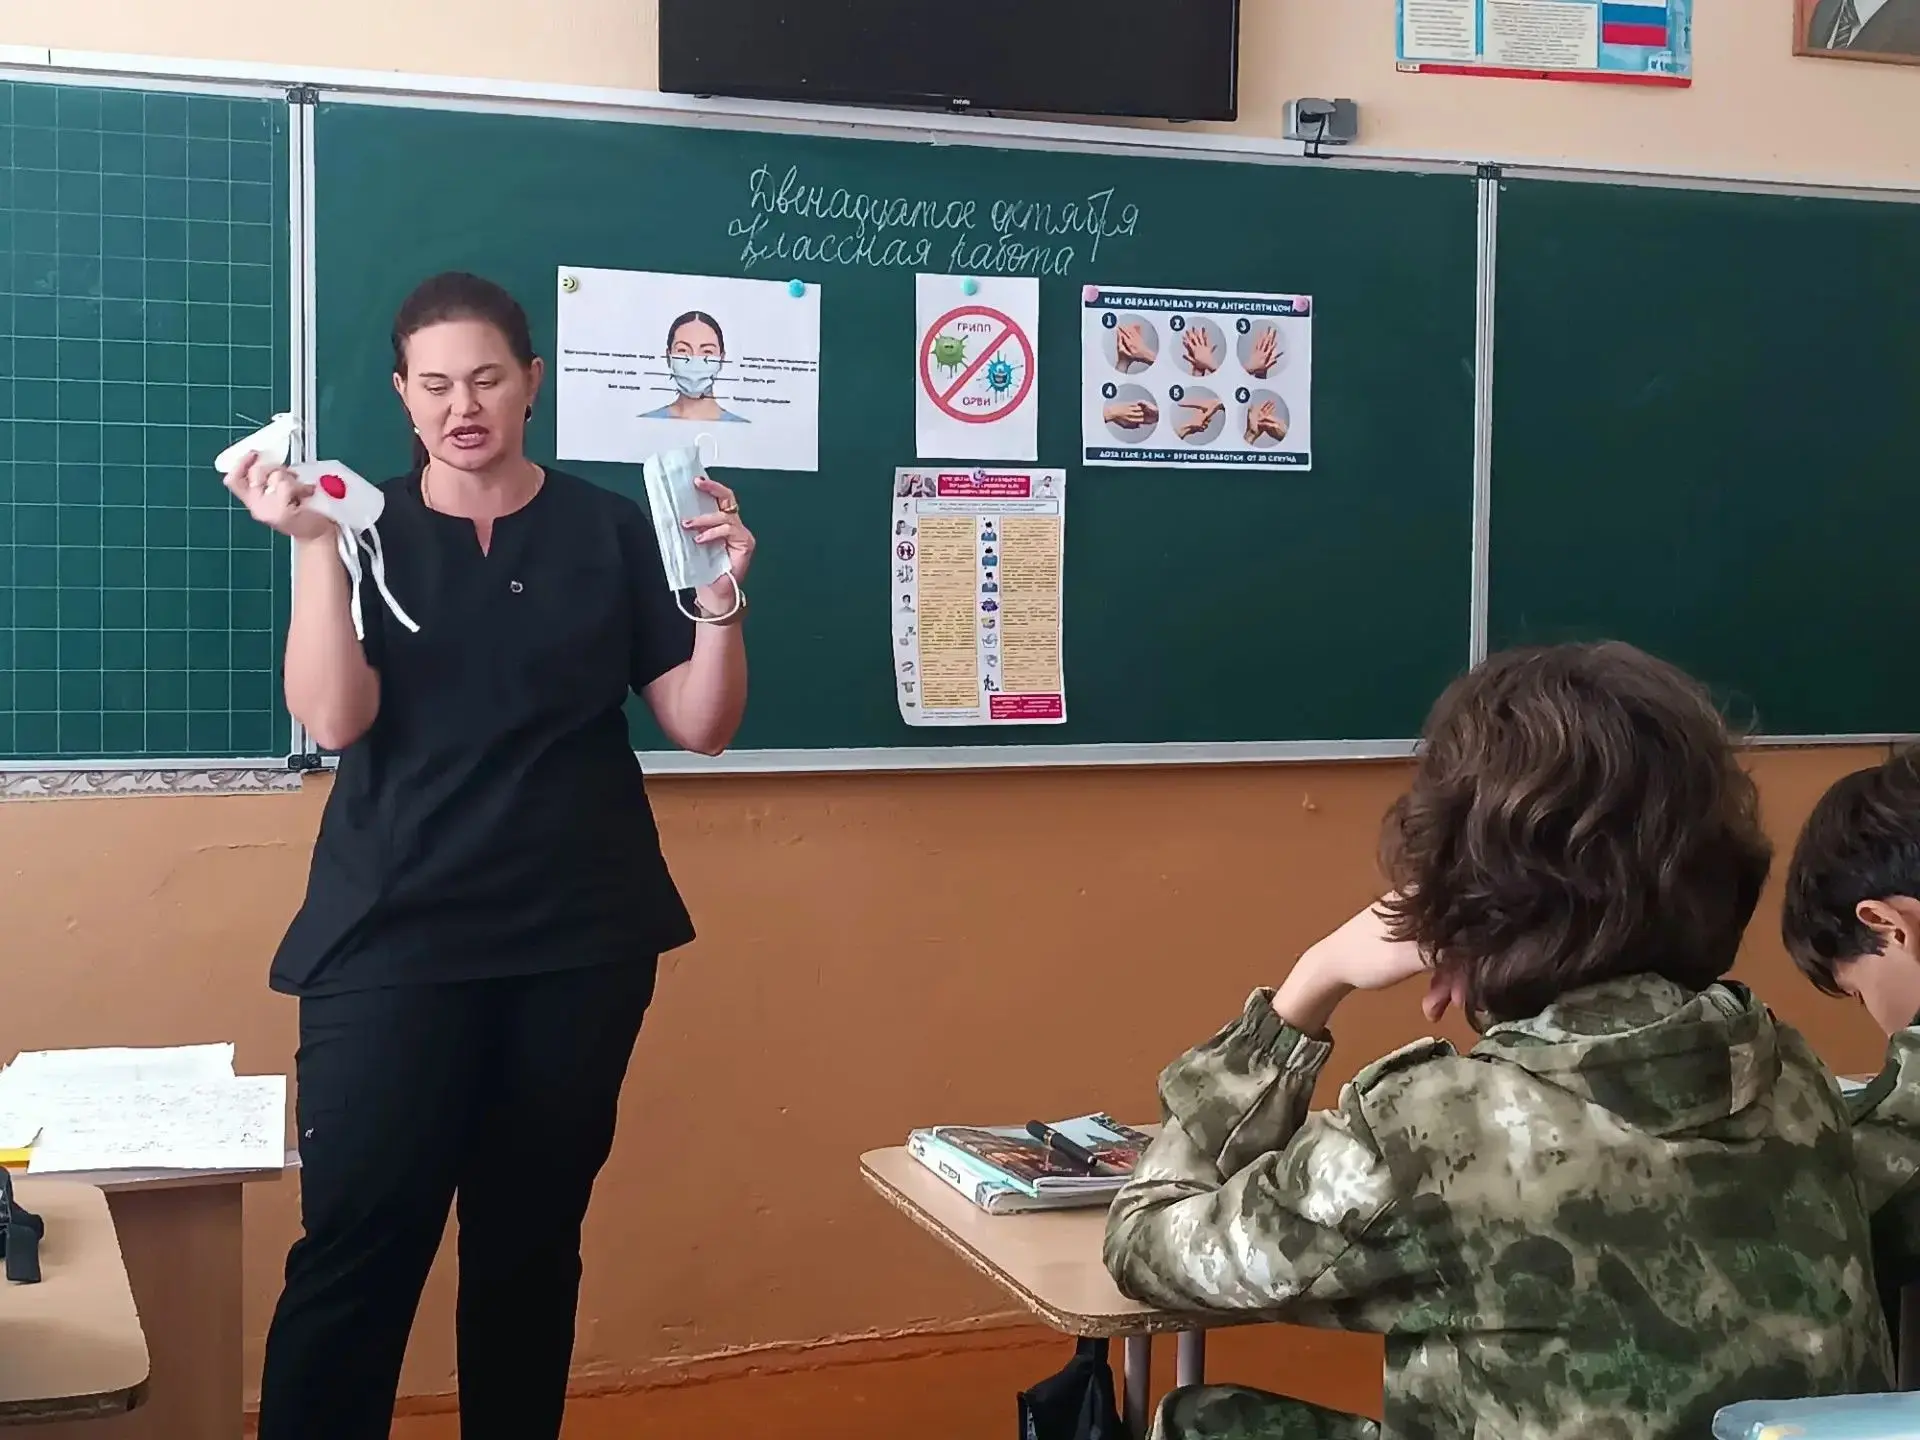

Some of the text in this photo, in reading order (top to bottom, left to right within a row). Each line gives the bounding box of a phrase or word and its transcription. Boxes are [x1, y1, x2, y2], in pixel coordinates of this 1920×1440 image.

[749, 163, 1140, 264] Двенадцатое октября
[727, 211, 1075, 277] Классная работа
[1104, 296, 1122, 305] КАК
[957, 322, 991, 332] ГРИПП
[962, 397, 991, 406] ОРВИ
